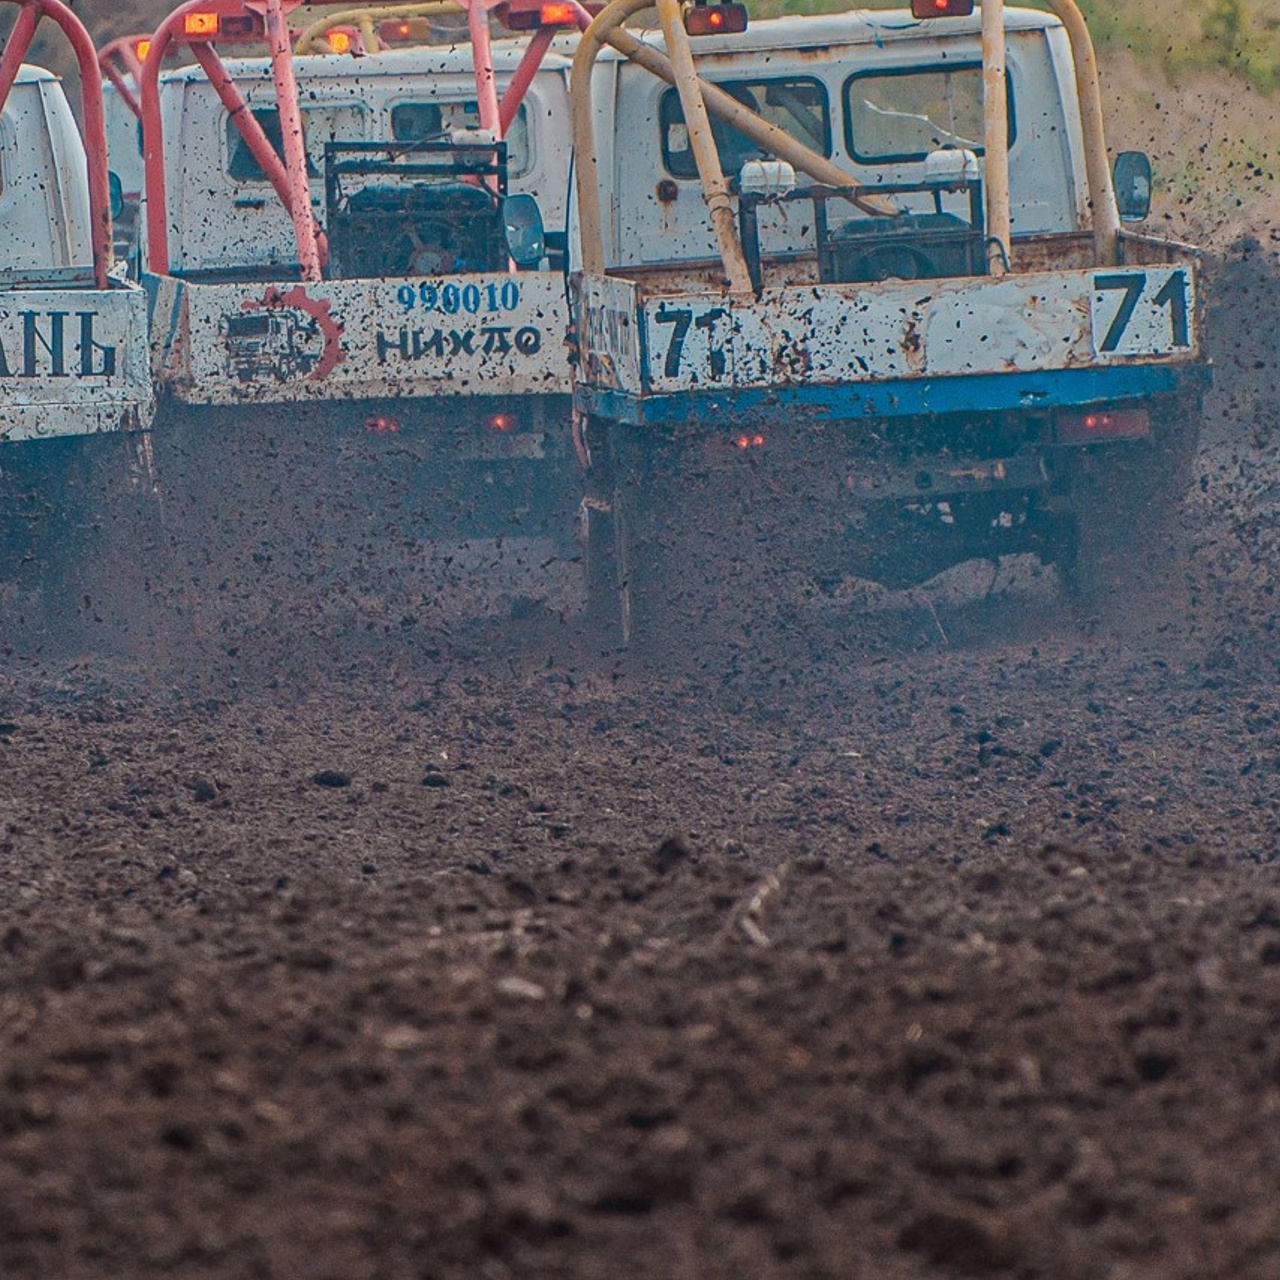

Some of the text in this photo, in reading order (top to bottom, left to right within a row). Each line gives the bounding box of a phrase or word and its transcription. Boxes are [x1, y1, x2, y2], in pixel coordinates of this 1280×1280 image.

[397, 280, 519, 315] 990010
[1094, 270, 1189, 352] 71
[655, 308, 726, 382] 71
